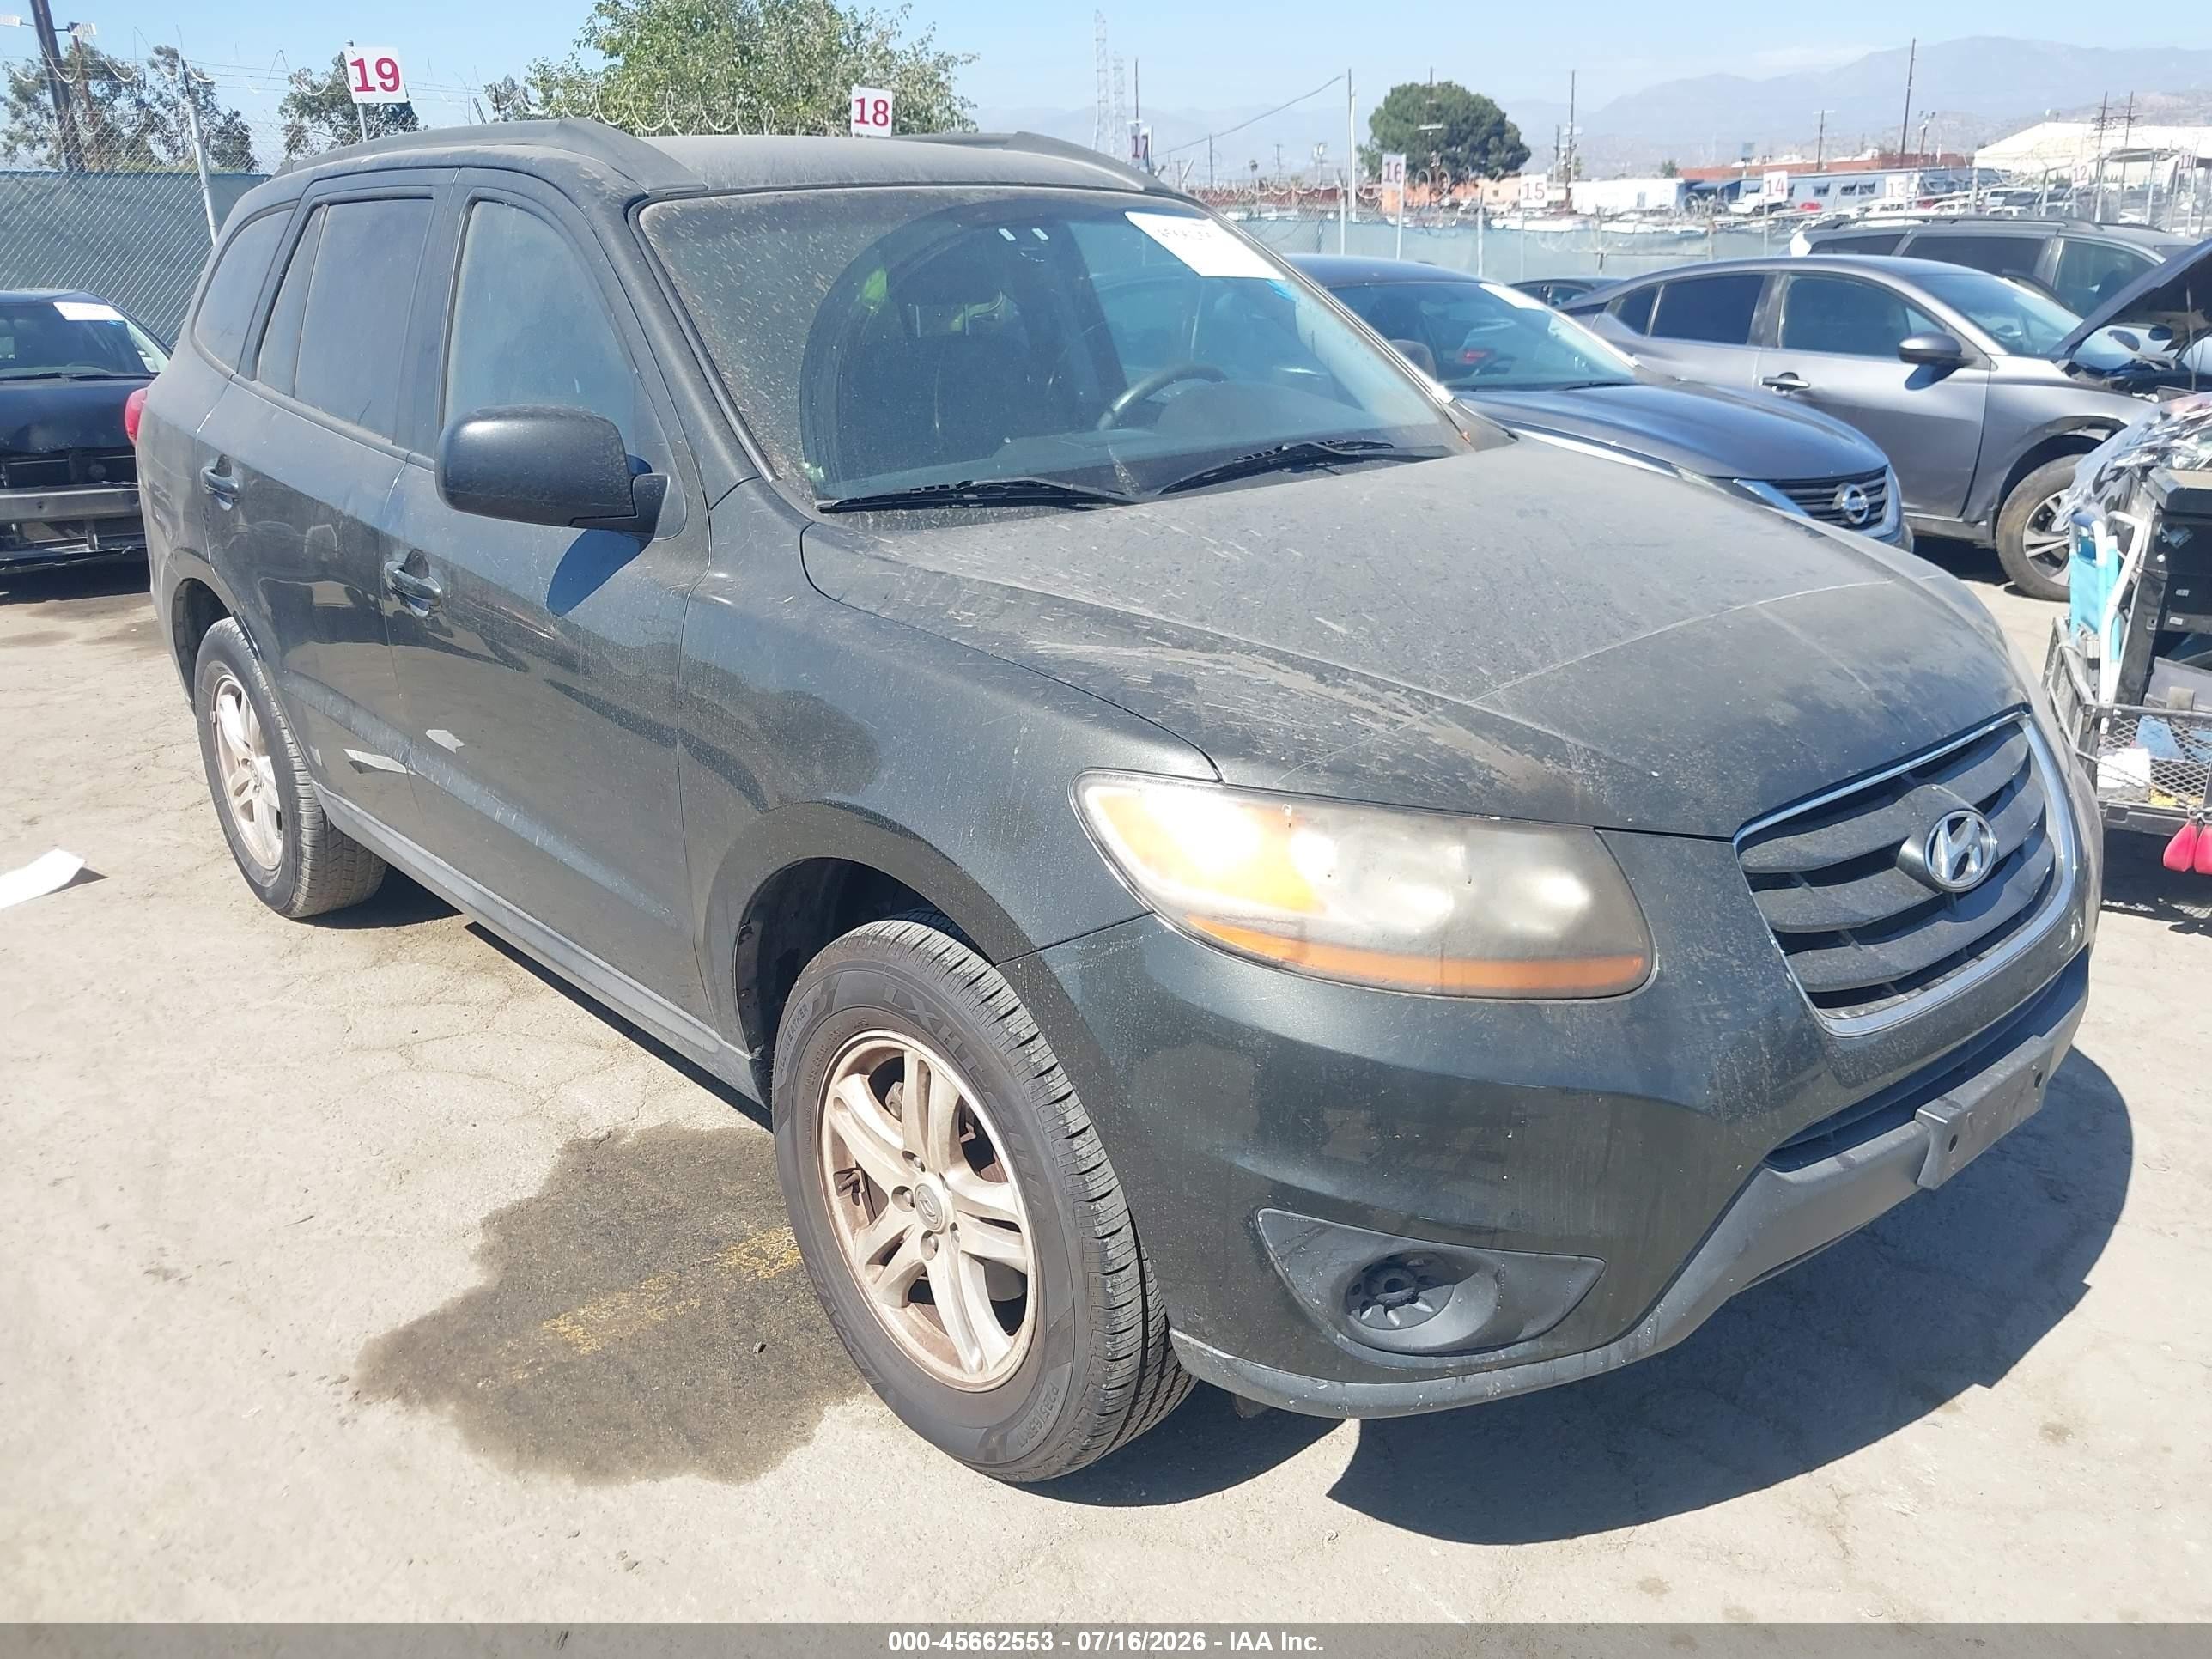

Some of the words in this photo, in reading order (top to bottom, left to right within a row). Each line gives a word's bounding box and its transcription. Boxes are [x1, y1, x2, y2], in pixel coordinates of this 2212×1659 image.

[349, 58, 400, 92] 19
[854, 97, 889, 126] 18
[1132, 134, 1149, 160] 17
[1383, 161, 1401, 184] 16
[2073, 166, 2088, 183] 12
[1522, 182, 1545, 200] 15
[1765, 178, 1785, 197] 14
[1887, 182, 1905, 198] 13
[785, 1002, 810, 1051] WEATHER
[1016, 1380, 1060, 1449] P235/65R17
